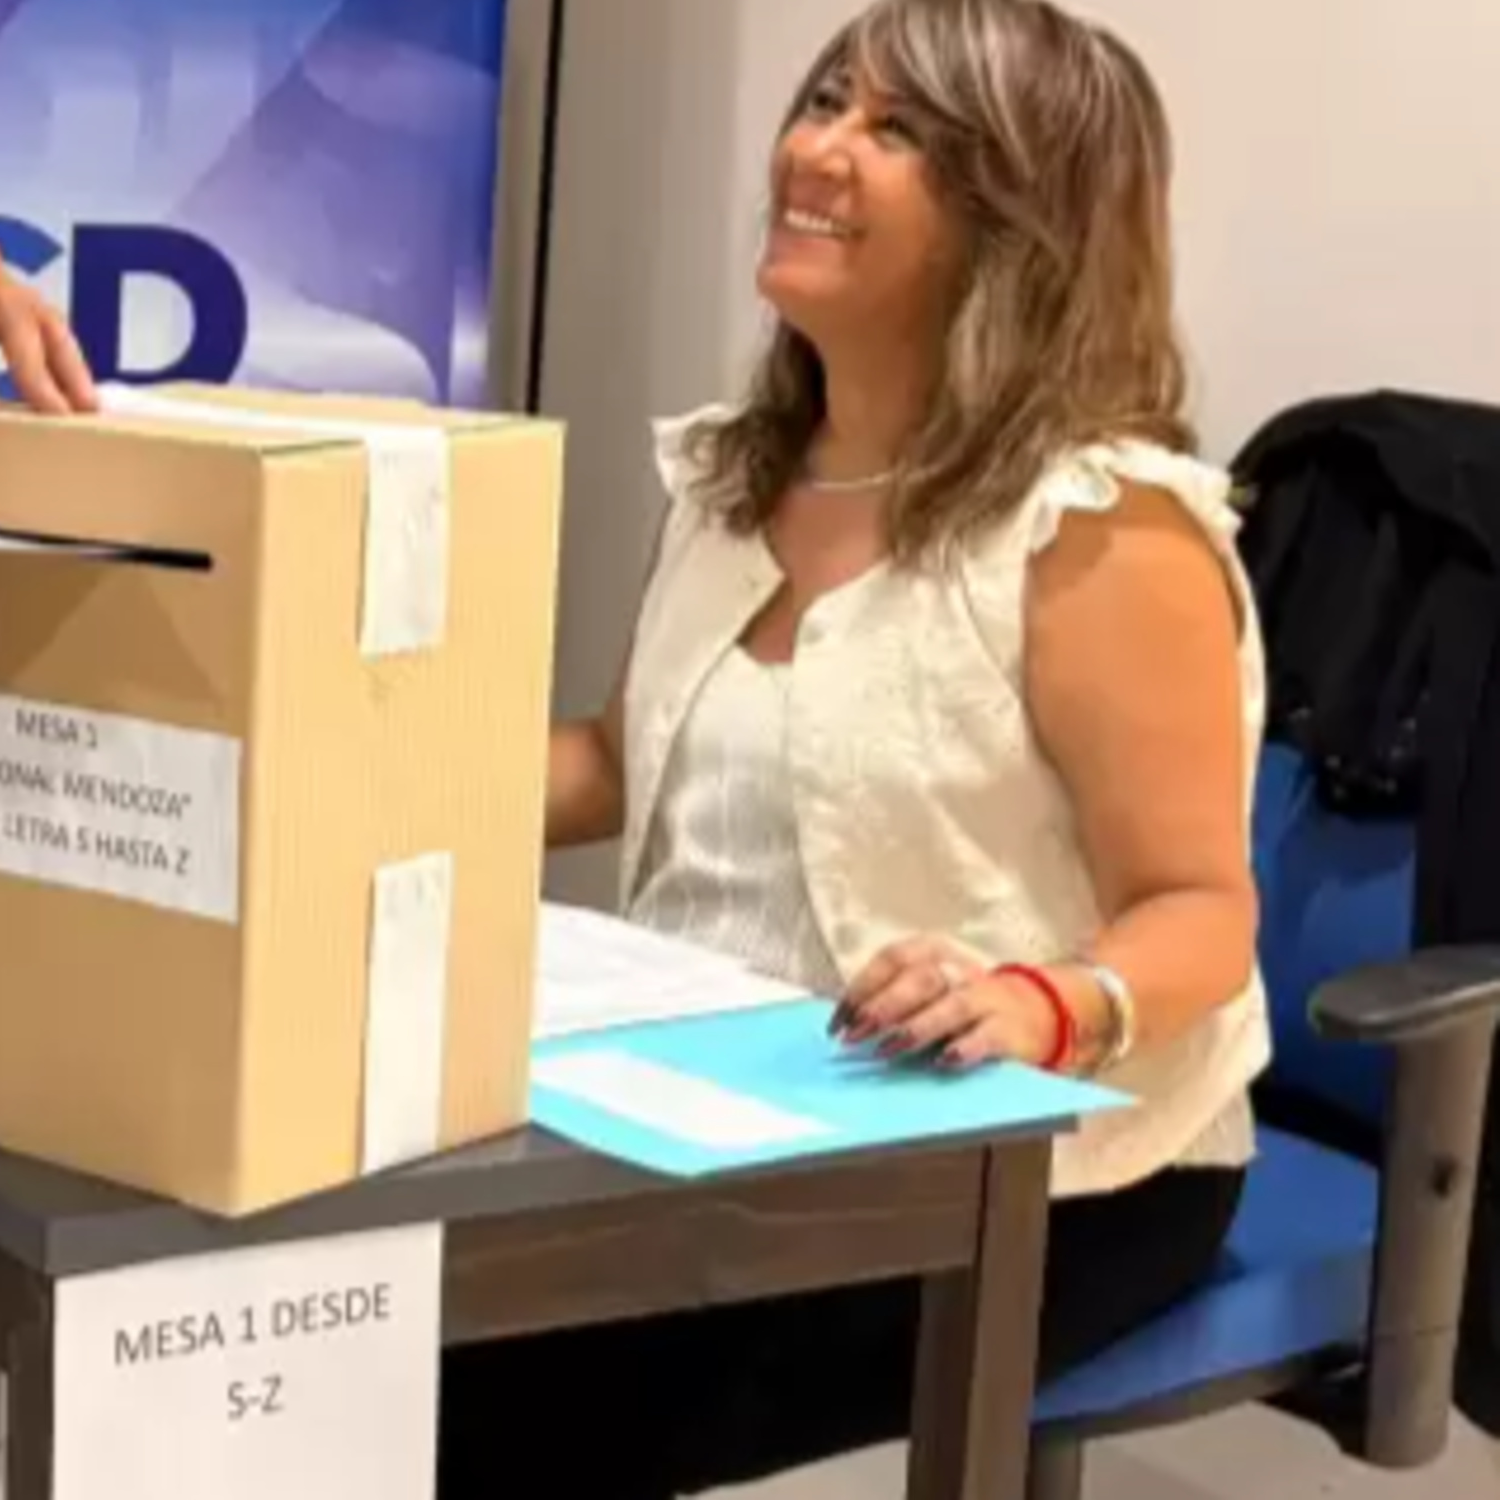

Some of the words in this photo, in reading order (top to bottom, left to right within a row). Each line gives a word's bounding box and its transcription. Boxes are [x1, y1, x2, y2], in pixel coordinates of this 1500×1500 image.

[15, 707, 79, 745] MESA
[86, 723, 98, 749] 1
[62, 771, 192, 820] MENDOZA"
[3, 812, 70, 851] LETRA
[76, 825, 90, 851] S
[95, 831, 169, 871] HASTA
[175, 848, 191, 876] Z
[113, 1311, 226, 1367] MESA
[238, 1305, 258, 1344] 1
[270, 1282, 392, 1339] DESDE
[227, 1373, 284, 1421] S-Z
